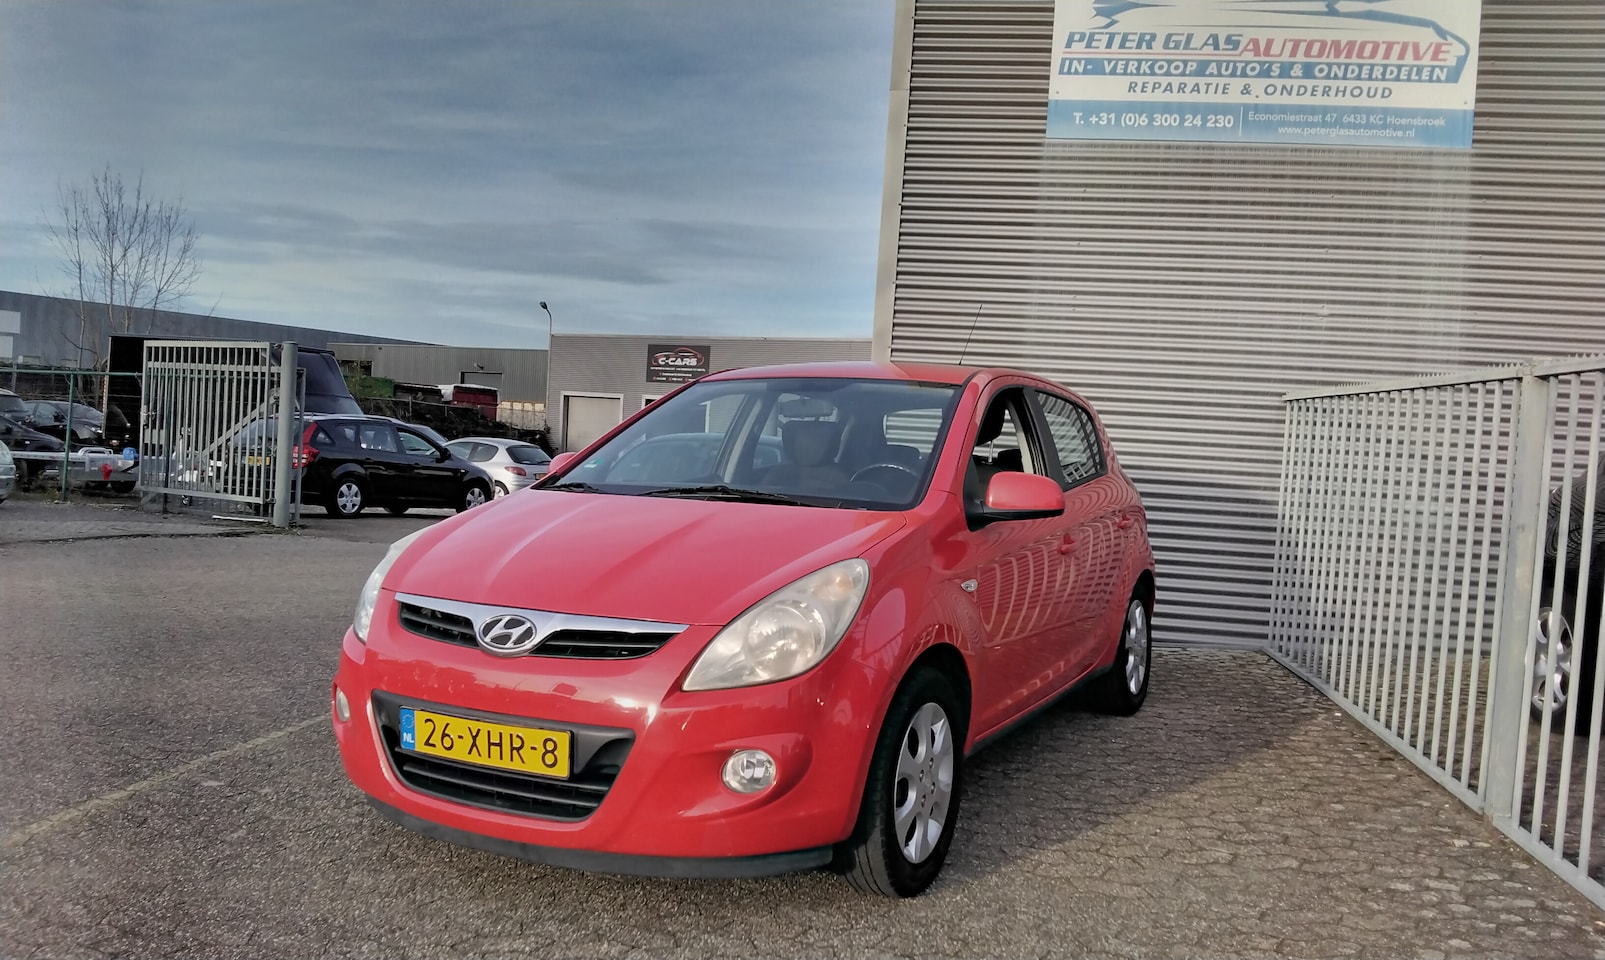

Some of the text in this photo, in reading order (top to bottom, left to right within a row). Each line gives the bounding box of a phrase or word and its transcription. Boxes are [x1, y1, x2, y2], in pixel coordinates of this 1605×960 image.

[1064, 31, 1157, 50] PETER
[1063, 60, 1448, 81] IN- VERKOOP AUTO'S & ONDERDELEN
[1128, 81, 1393, 99] REPARATIE & ONDERHOUD
[1073, 112, 1234, 127] T. +31 (0)6 300 24 230
[1248, 112, 1446, 126] Economiestraat 47 6433 KC Hoensbroek
[1278, 124, 1415, 137] www.peterglasautomotive.nl
[658, 357, 697, 366] C-CARS
[403, 732, 415, 743] NL
[423, 718, 558, 769] 26-XHR-8
